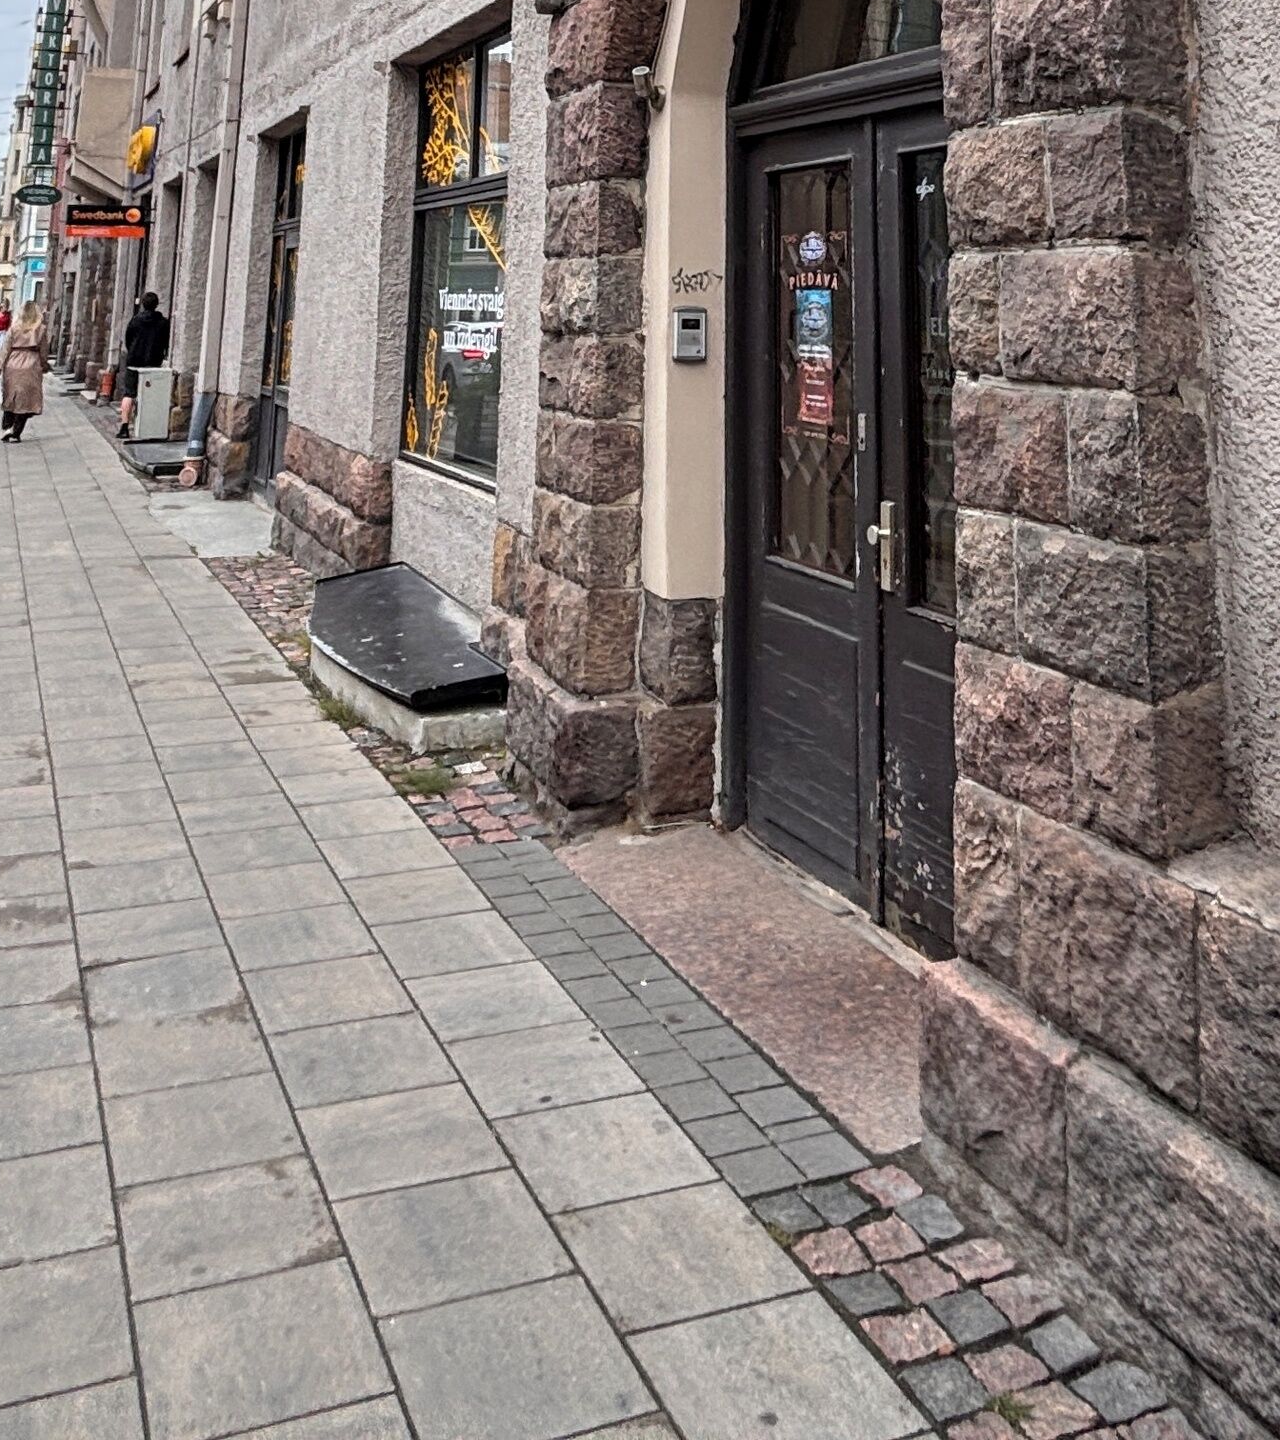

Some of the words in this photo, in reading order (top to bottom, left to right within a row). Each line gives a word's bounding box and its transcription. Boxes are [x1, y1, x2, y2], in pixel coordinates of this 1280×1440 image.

[72, 211, 125, 220] Swedbank
[789, 269, 838, 291] PIEDĀVĀ
[477, 286, 505, 319] svaig
